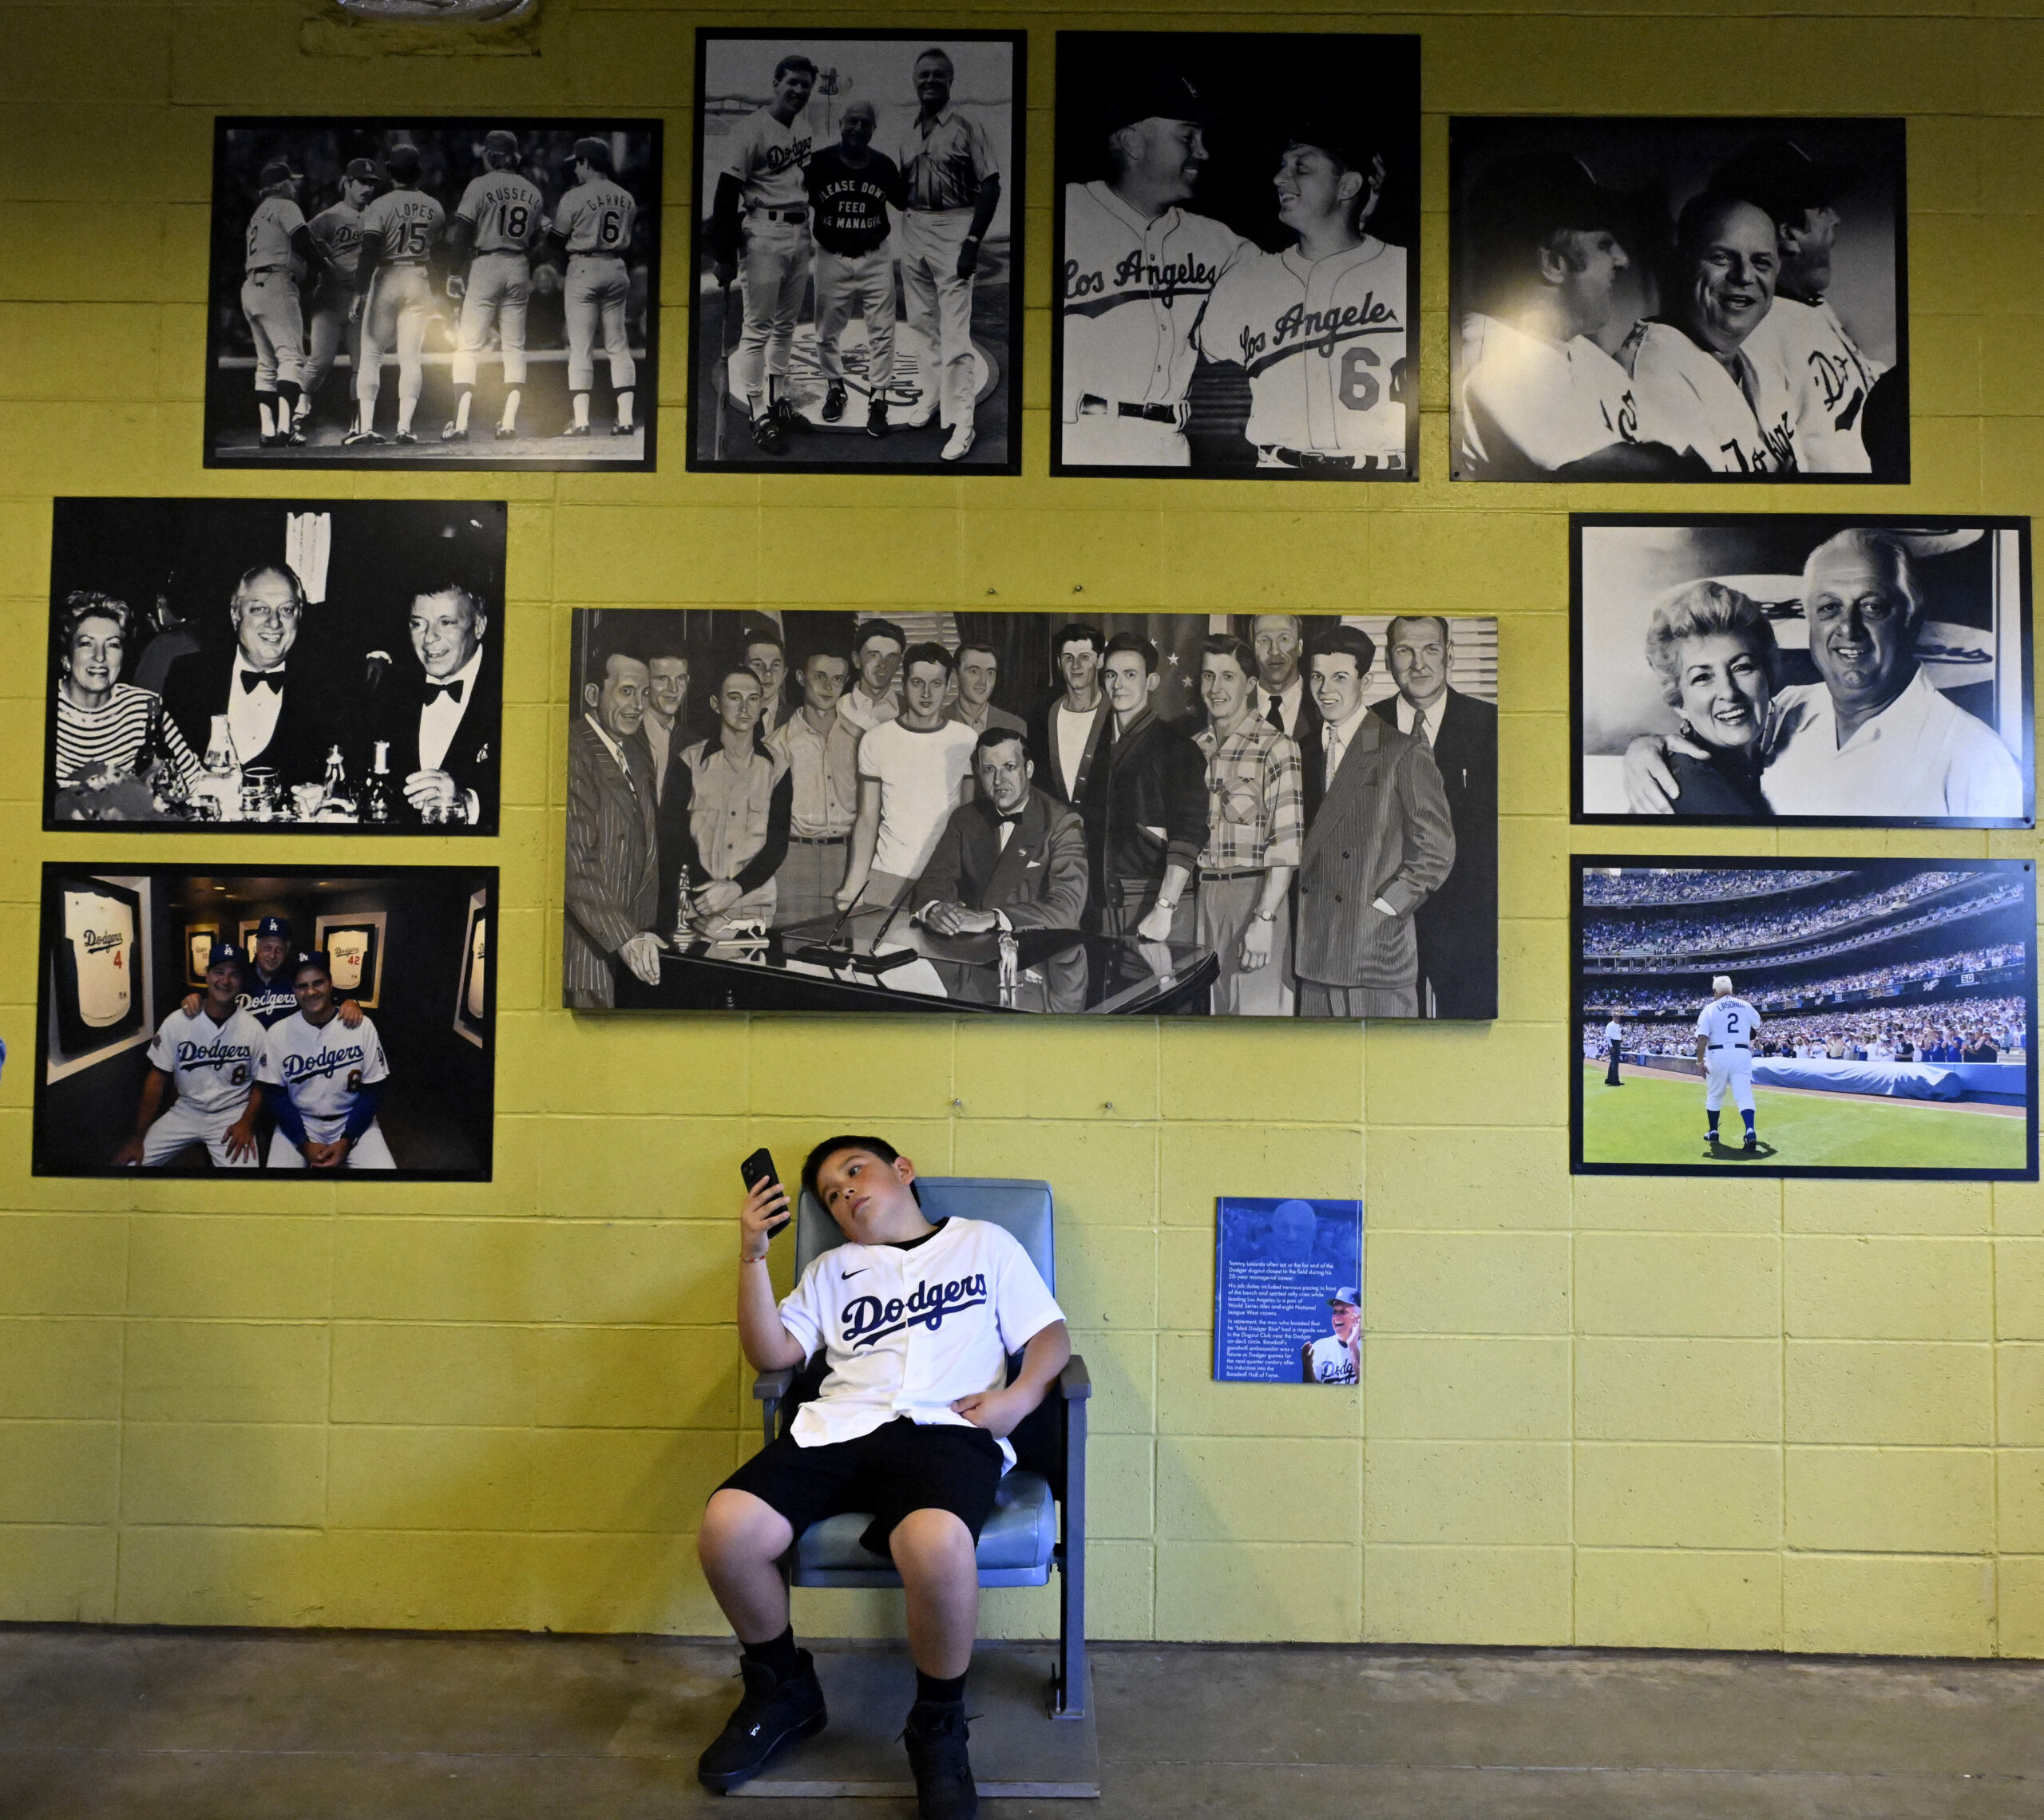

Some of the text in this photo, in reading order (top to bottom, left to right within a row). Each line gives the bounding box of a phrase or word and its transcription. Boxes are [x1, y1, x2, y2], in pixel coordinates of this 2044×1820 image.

[394, 203, 434, 220] LOPES
[499, 204, 528, 238] 18
[838, 200, 866, 213] FEED
[398, 222, 429, 255] 15
[602, 211, 620, 243] 6
[1064, 259, 1104, 299] Los
[1239, 325, 1266, 368] Los
[1339, 347, 1380, 411] 6
[113, 950, 122, 969] 4
[235, 989, 297, 1015] Dodgers
[1727, 1012, 1739, 1033] 2
[178, 1039, 250, 1070] Dodgers
[283, 1044, 364, 1078] Dodgers
[231, 1063, 246, 1086] 8
[841, 1273, 988, 1341] Dodgers
